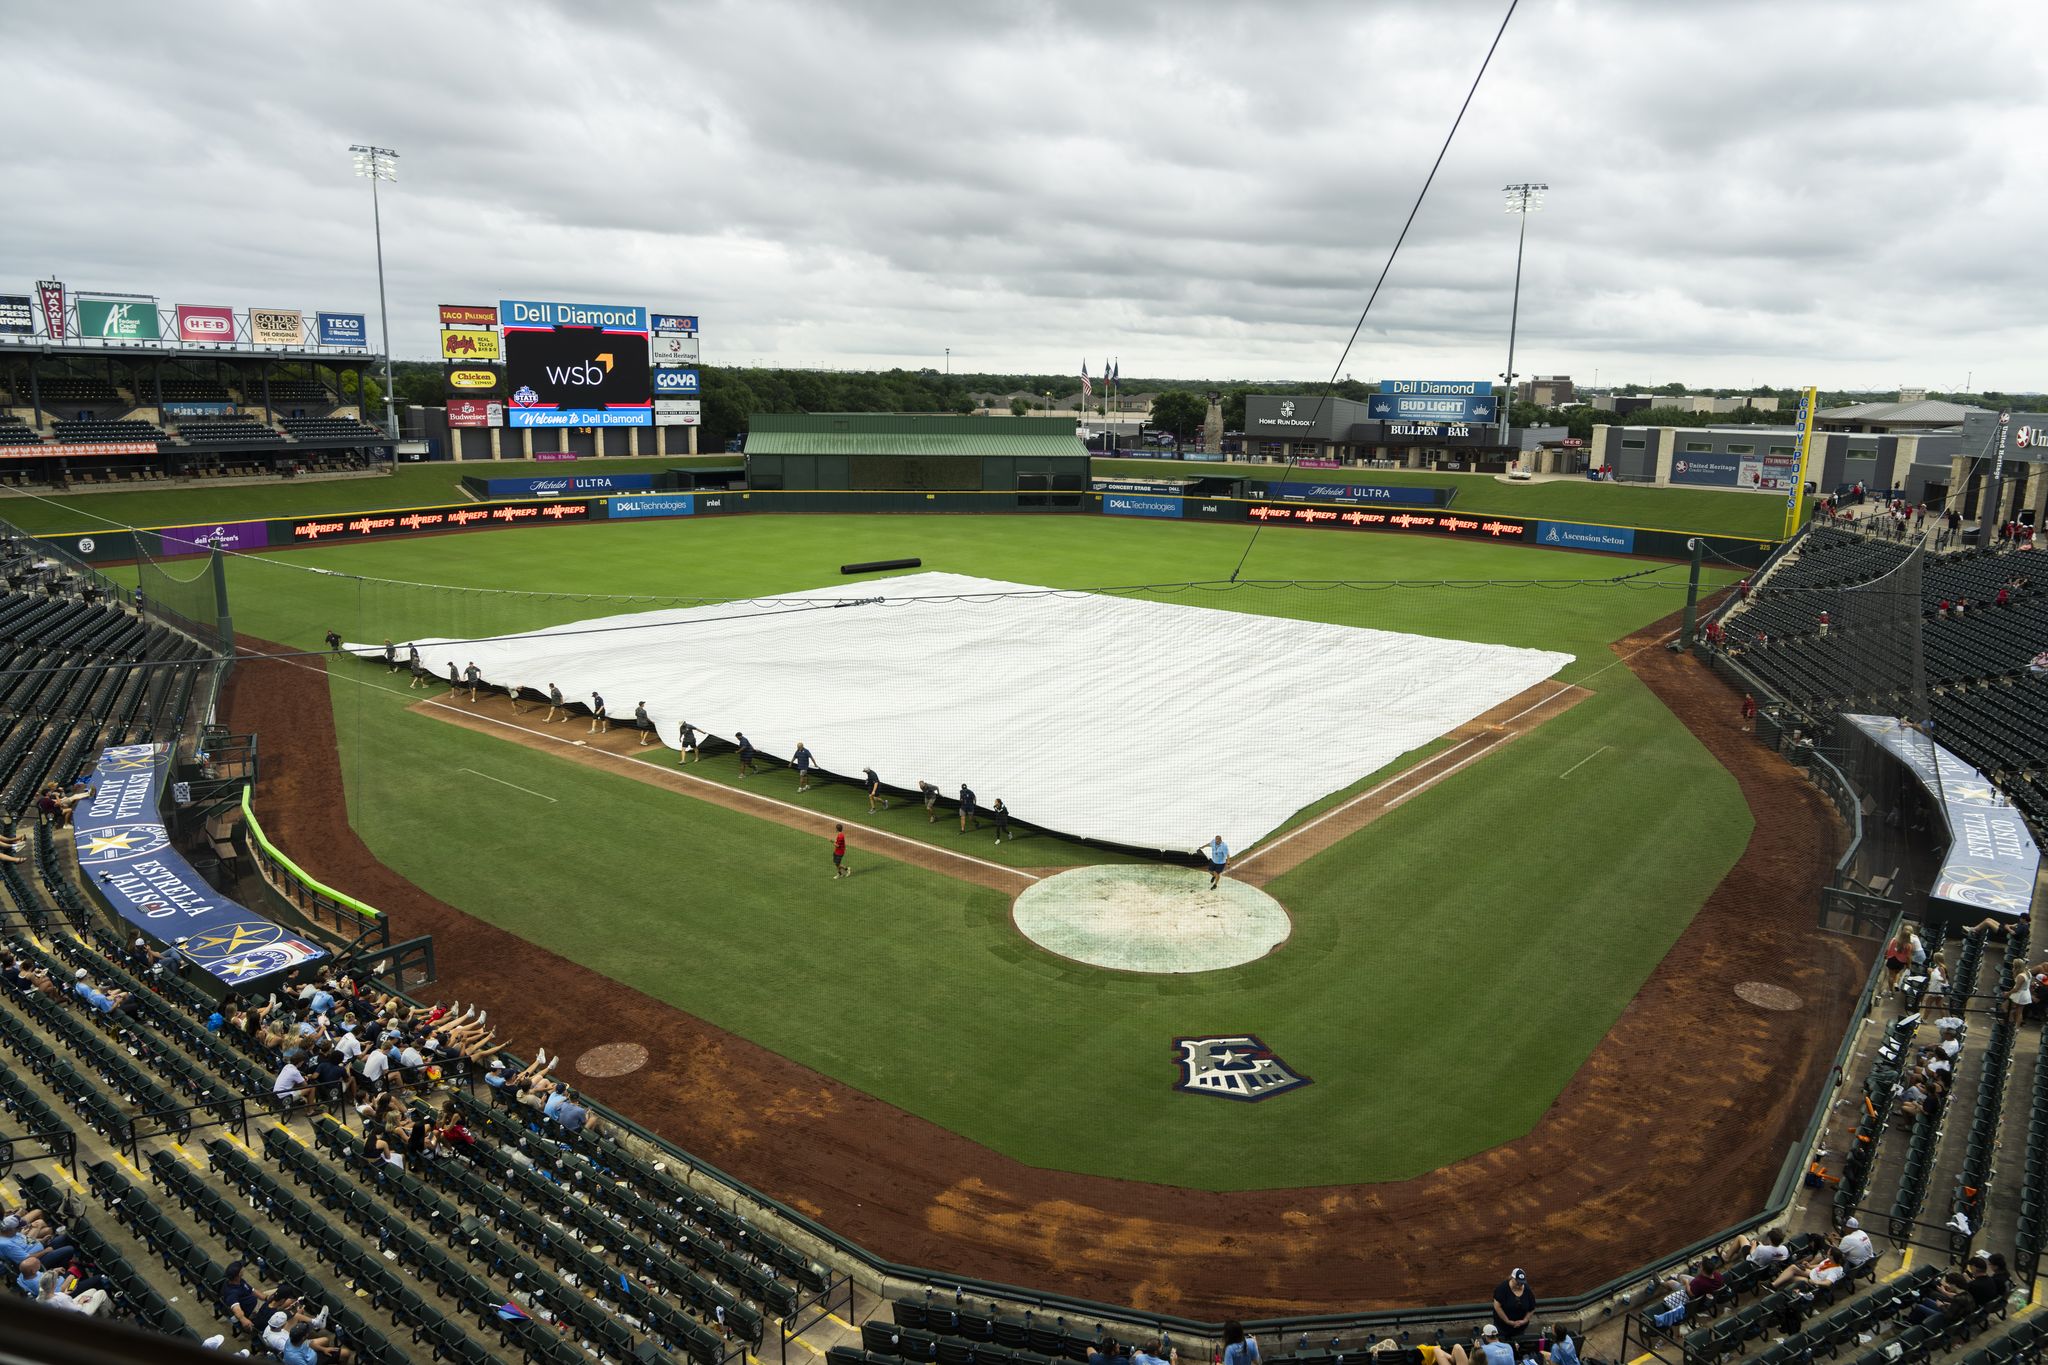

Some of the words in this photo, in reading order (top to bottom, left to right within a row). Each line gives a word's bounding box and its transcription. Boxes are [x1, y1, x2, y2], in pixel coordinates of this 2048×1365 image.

[41, 281, 61, 290] Nyle
[45, 291, 62, 339] MAXWELL
[103, 304, 133, 336] A+
[255, 314, 298, 324] GOLDEN
[465, 312, 495, 320] PALENQUE
[514, 303, 550, 322] Dell
[558, 306, 637, 326] Diamond
[260, 322, 293, 330] CHICK
[327, 319, 359, 328] TECO
[446, 334, 477, 354] Rudy's
[546, 359, 603, 385] wsb
[657, 374, 696, 387] GOYA
[1393, 381, 1416, 393] Dell
[1421, 382, 1475, 395] Diamond
[1400, 401, 1425, 410] BUD
[1426, 401, 1464, 412] LIGHT
[520, 413, 567, 426] Welcome
[569, 413, 580, 425] to
[582, 414, 600, 423] Dell
[603, 414, 644, 424] Diamond
[1796, 397, 1809, 443] CODY
[1391, 425, 1438, 436] BULLPEN
[1447, 427, 1469, 437] BAR
[2000, 426, 2009, 449] United
[1993, 449, 2005, 480] Heritage
[529, 480, 567, 491] Michelob
[576, 478, 612, 488] ULTRA
[1787, 451, 1802, 509] POOLS
[1308, 486, 1344, 497] Michelob
[1354, 488, 1391, 499] ULTRA
[617, 501, 640, 511] DELL
[640, 500, 687, 512] Technologies
[706, 499, 721, 507] intel
[1110, 499, 1131, 508] DELL
[1131, 500, 1175, 512] Technologies
[1202, 504, 1217, 512] intel
[448, 510, 488, 525] MAXPREPS
[493, 507, 537, 521] MAXPREPS
[543, 504, 586, 518] MAXPREPS
[1295, 508, 1337, 522] MAXPREPS
[1341, 511, 1385, 525] MAXPREPS
[349, 518, 395, 534] MAXPREPS
[400, 514, 443, 529] MAXPREPS
[1390, 514, 1434, 528] MAXPREPS
[1439, 517, 1478, 531] MAXPREPS
[295, 522, 344, 538] MAXPREPS
[1482, 521, 1523, 536] MAXPREPS
[1562, 531, 1600, 544] Ascension
[1602, 534, 1625, 545] Seton
[82, 543, 92, 551] 32
[88, 779, 125, 817] JALISCO
[115, 772, 153, 819] ESTRELLA
[1962, 812, 1994, 860] ESTRELLA
[1990, 819, 2024, 860] JALISCO
[110, 871, 177, 919] JALISCO
[132, 859, 215, 918] ESTRELLA
